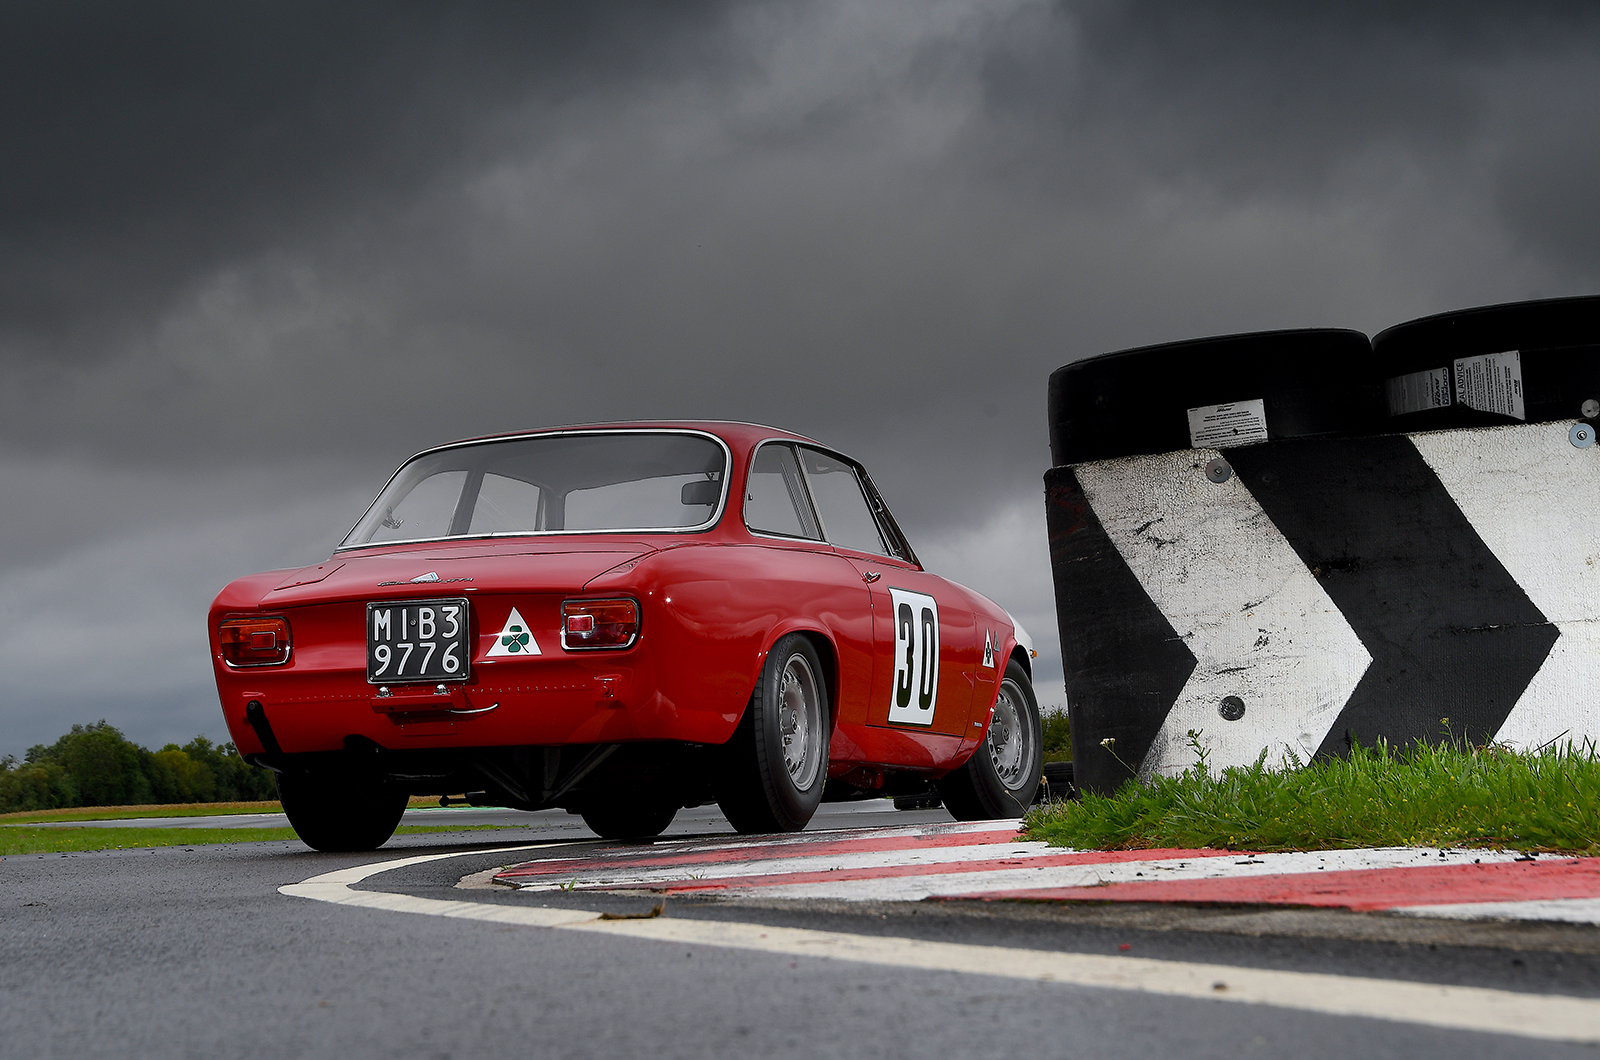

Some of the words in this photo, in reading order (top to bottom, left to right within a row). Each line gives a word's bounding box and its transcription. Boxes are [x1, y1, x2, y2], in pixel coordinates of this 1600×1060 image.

[1442, 368, 1450, 405] COOPER
[1456, 362, 1465, 389] ADVICE
[374, 641, 460, 677] 9776
[896, 603, 936, 710] 30
